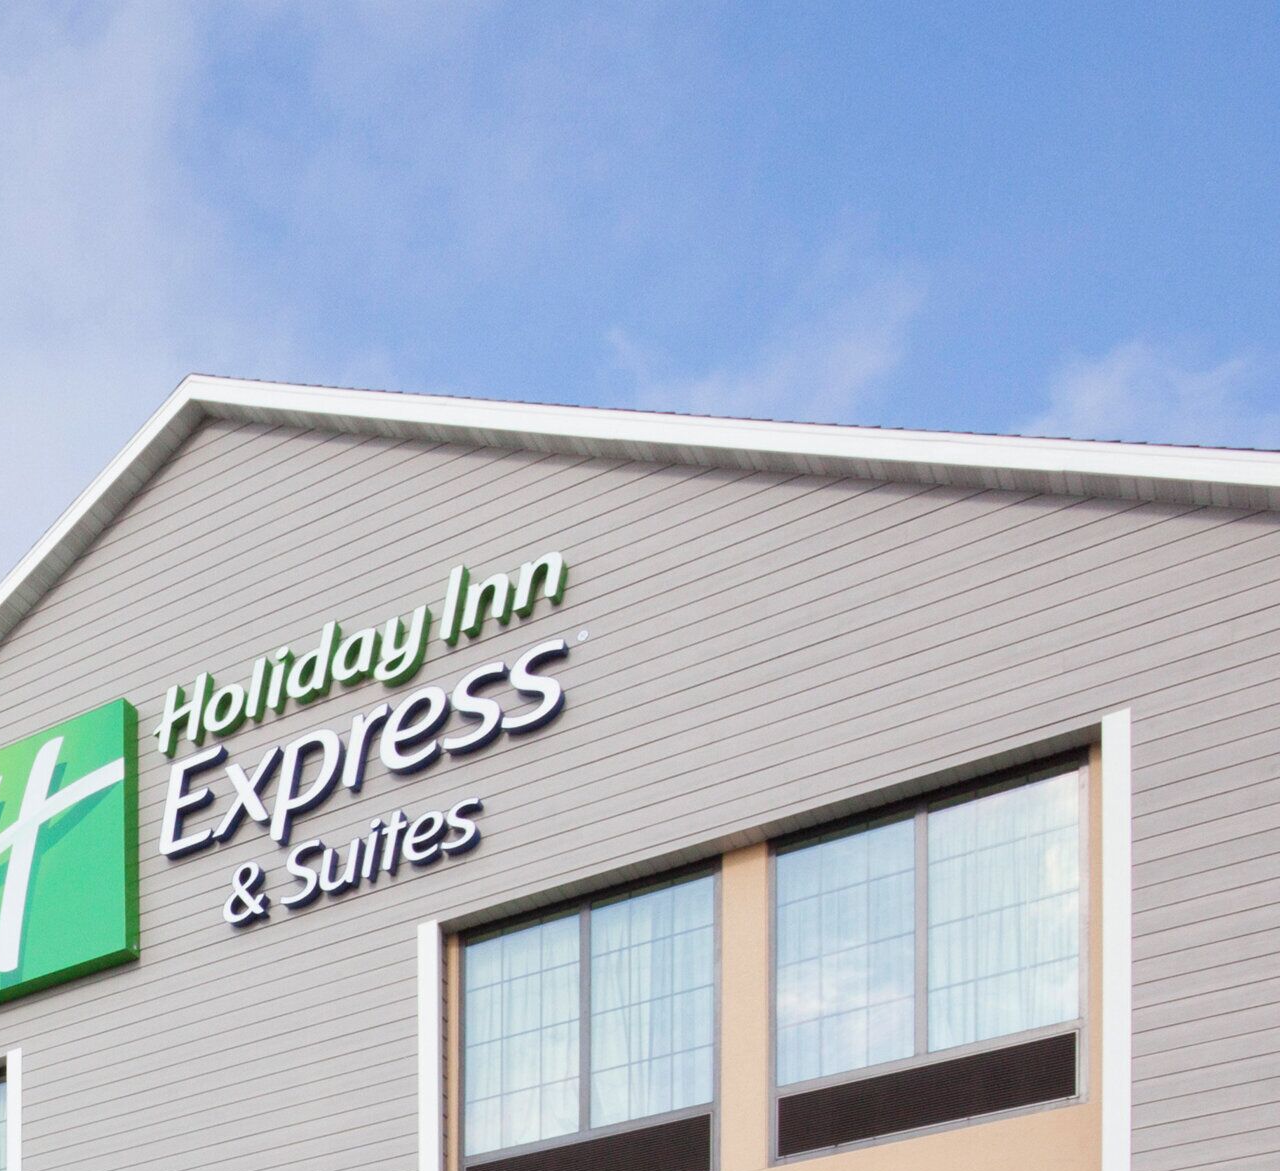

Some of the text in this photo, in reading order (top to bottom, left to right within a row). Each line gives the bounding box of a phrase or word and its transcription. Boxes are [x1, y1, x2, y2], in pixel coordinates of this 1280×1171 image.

[153, 551, 569, 757] Holiday Inn
[158, 638, 569, 860] Express
[222, 797, 484, 928] & Suites
